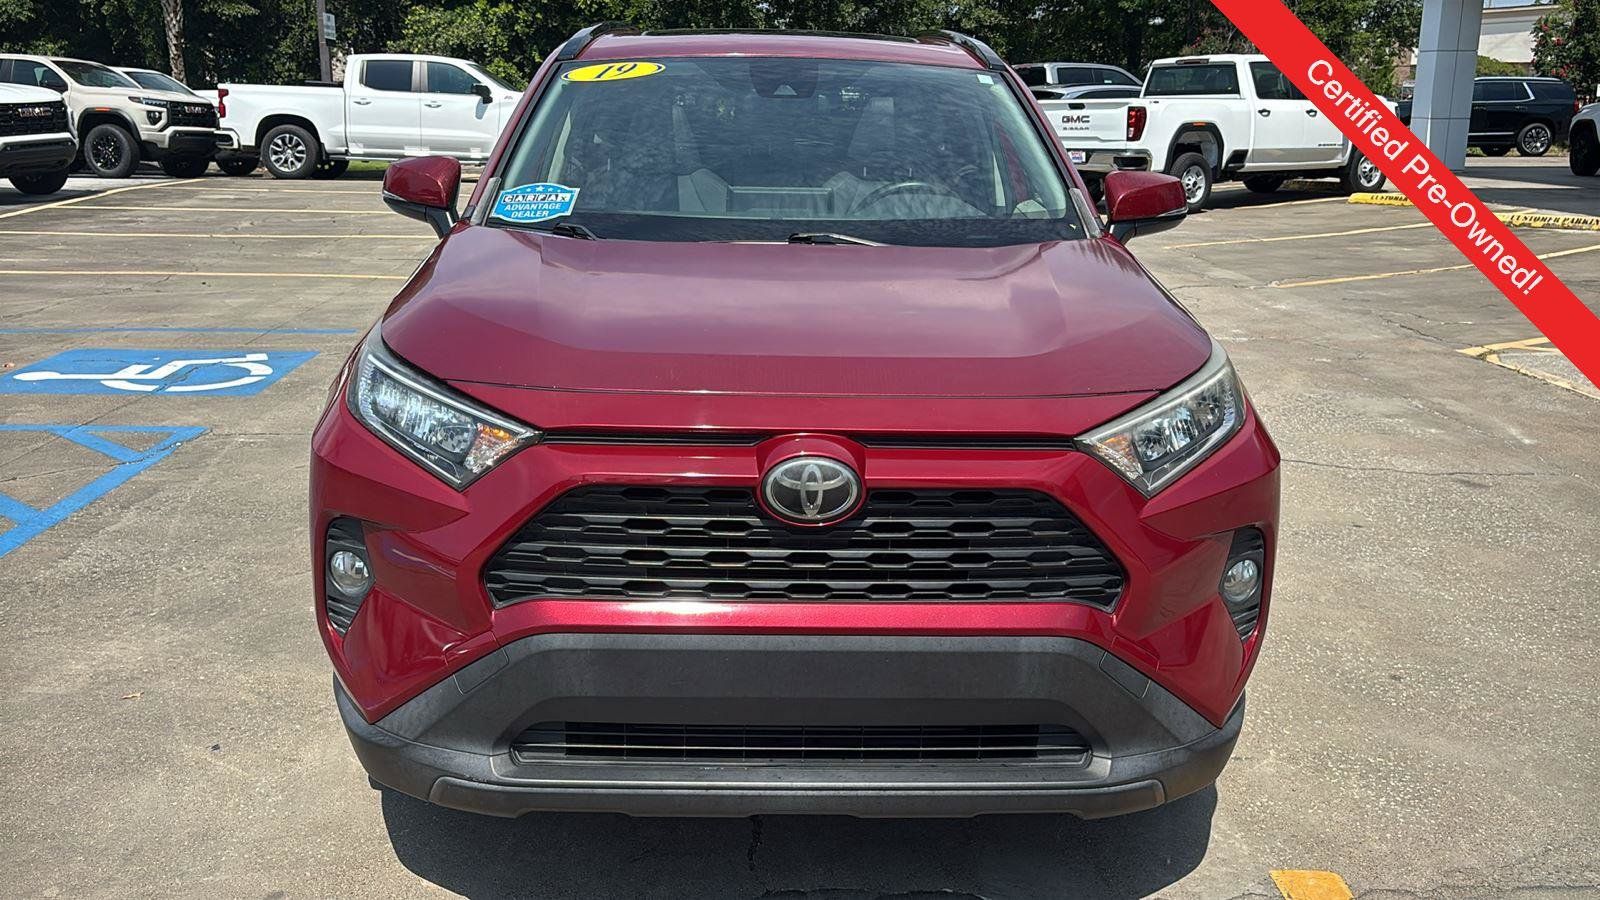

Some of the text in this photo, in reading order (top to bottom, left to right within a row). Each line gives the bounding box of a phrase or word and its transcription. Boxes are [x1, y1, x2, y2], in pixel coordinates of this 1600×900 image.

[593, 63, 638, 79] 19
[1062, 115, 1090, 124] GMC
[503, 193, 570, 203] CARFAX
[504, 203, 562, 211] ADVANTAGE
[511, 210, 549, 218] DEALER
[1510, 214, 1561, 223] CUSTOMER
